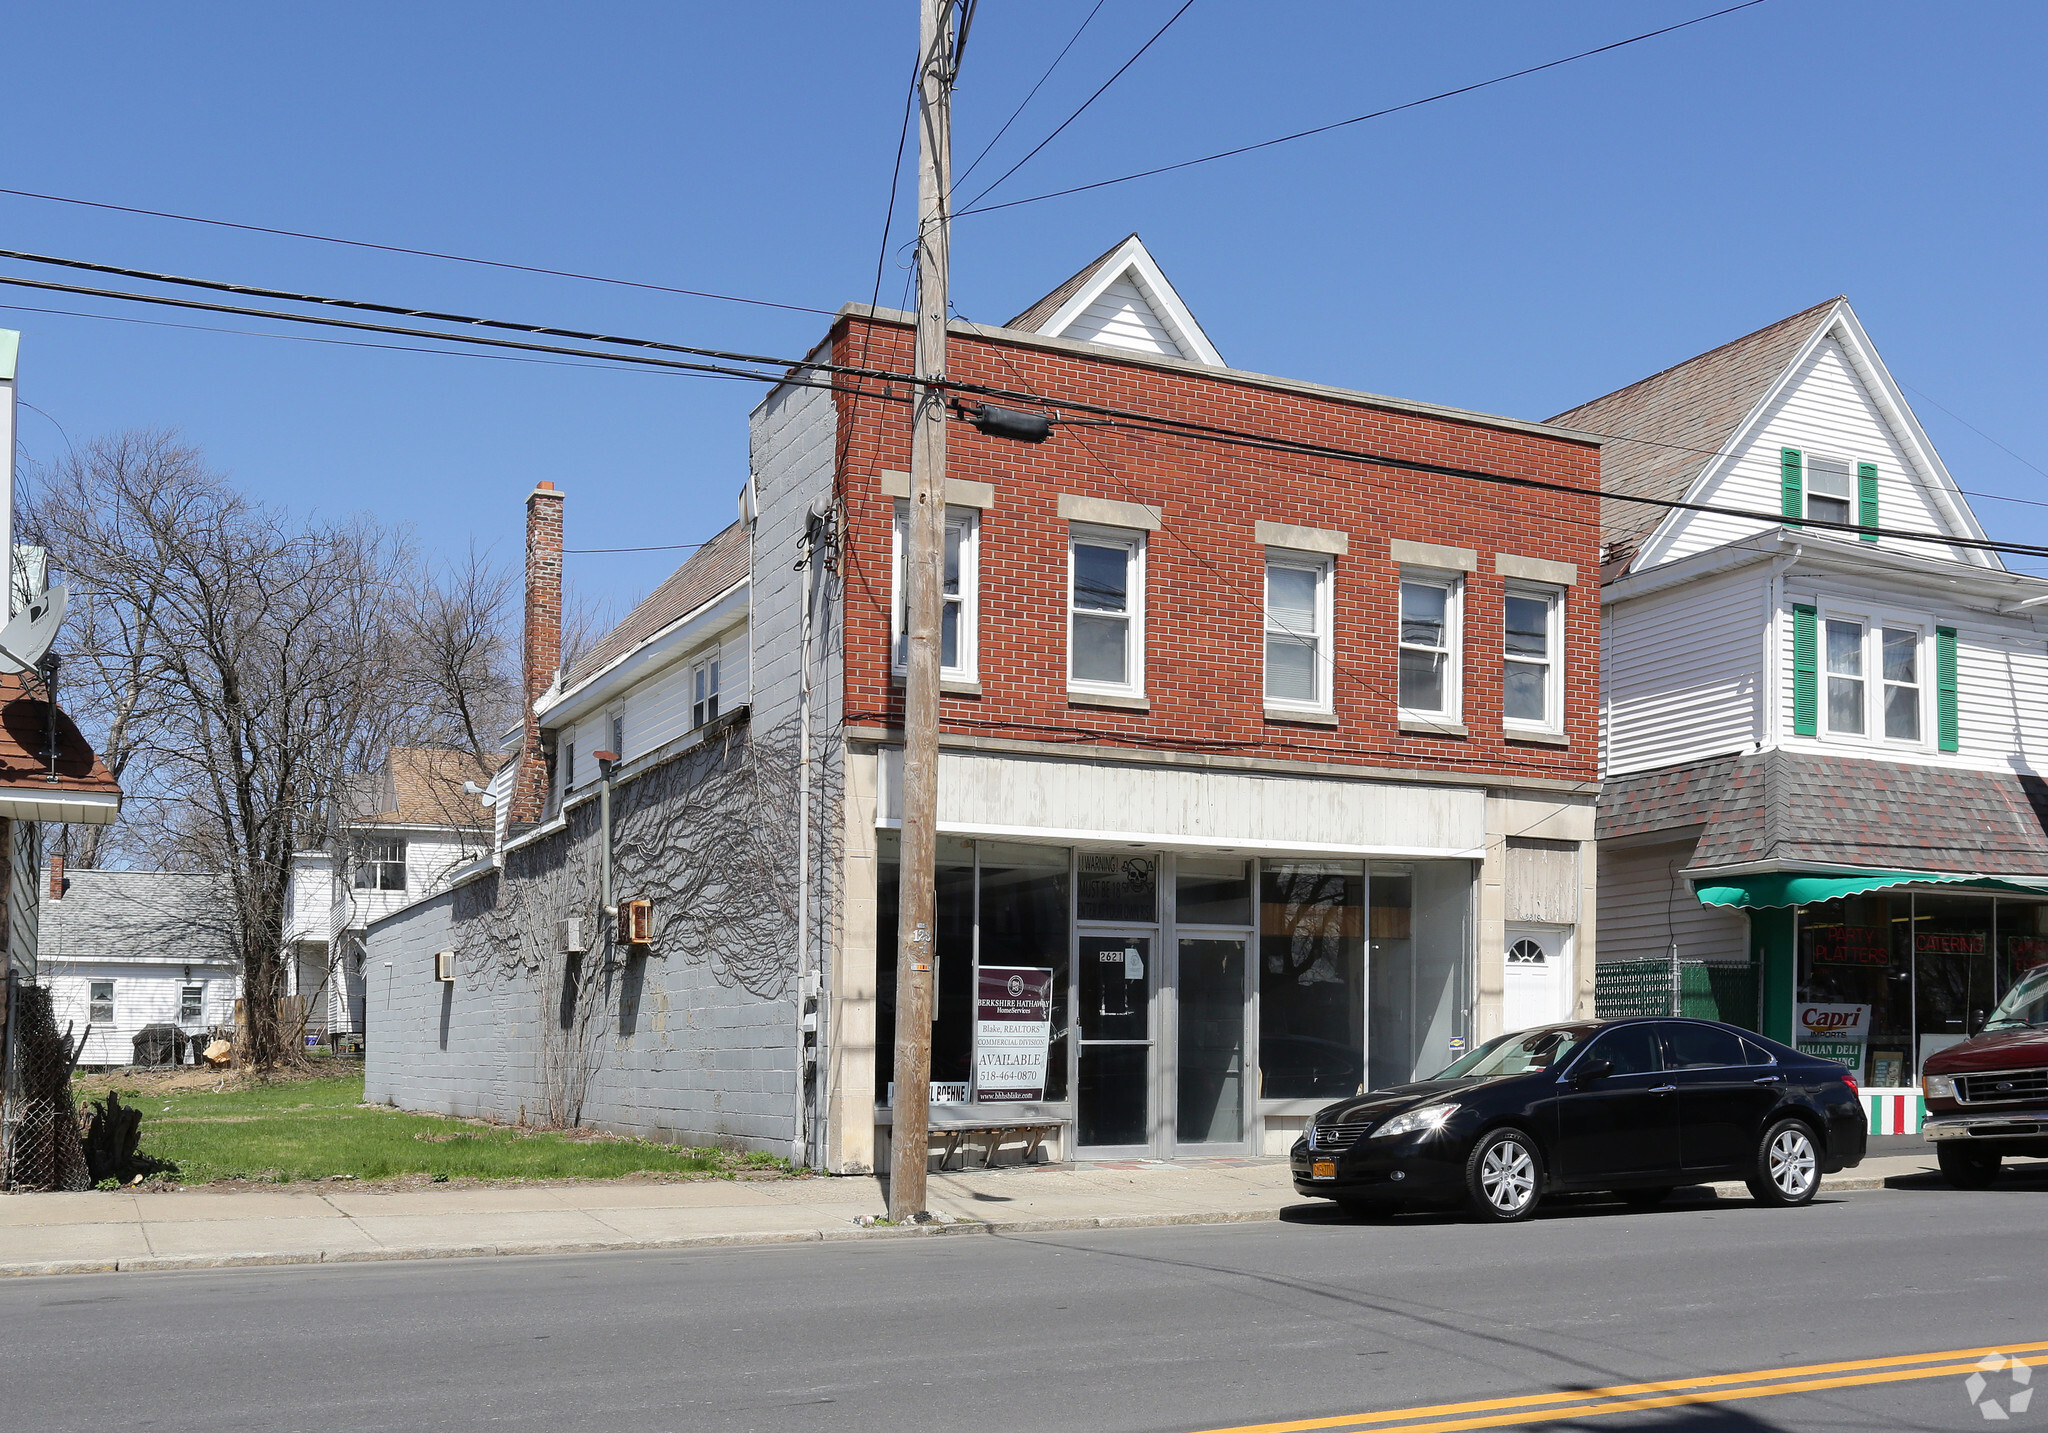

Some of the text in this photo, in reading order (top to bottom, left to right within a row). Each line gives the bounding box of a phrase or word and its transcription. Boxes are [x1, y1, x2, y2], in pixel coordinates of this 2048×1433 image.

[1828, 927, 1874, 944] PARTY
[1916, 935, 1984, 952] CATERING
[1100, 952, 1122, 961] 2621
[1815, 944, 1889, 964] PLATTERS
[978, 999, 1050, 1008] BERKSHIRE HATHAWAY
[1802, 1007, 1862, 1031] Capri
[982, 1024, 1003, 1034] Blake,
[1836, 1045, 1859, 1055] DELI
[979, 1053, 1041, 1066] AVAILABLE
[980, 1070, 1037, 1081] 518-464-0870
[980, 1091, 1033, 1100] www.bhhsblake.com
